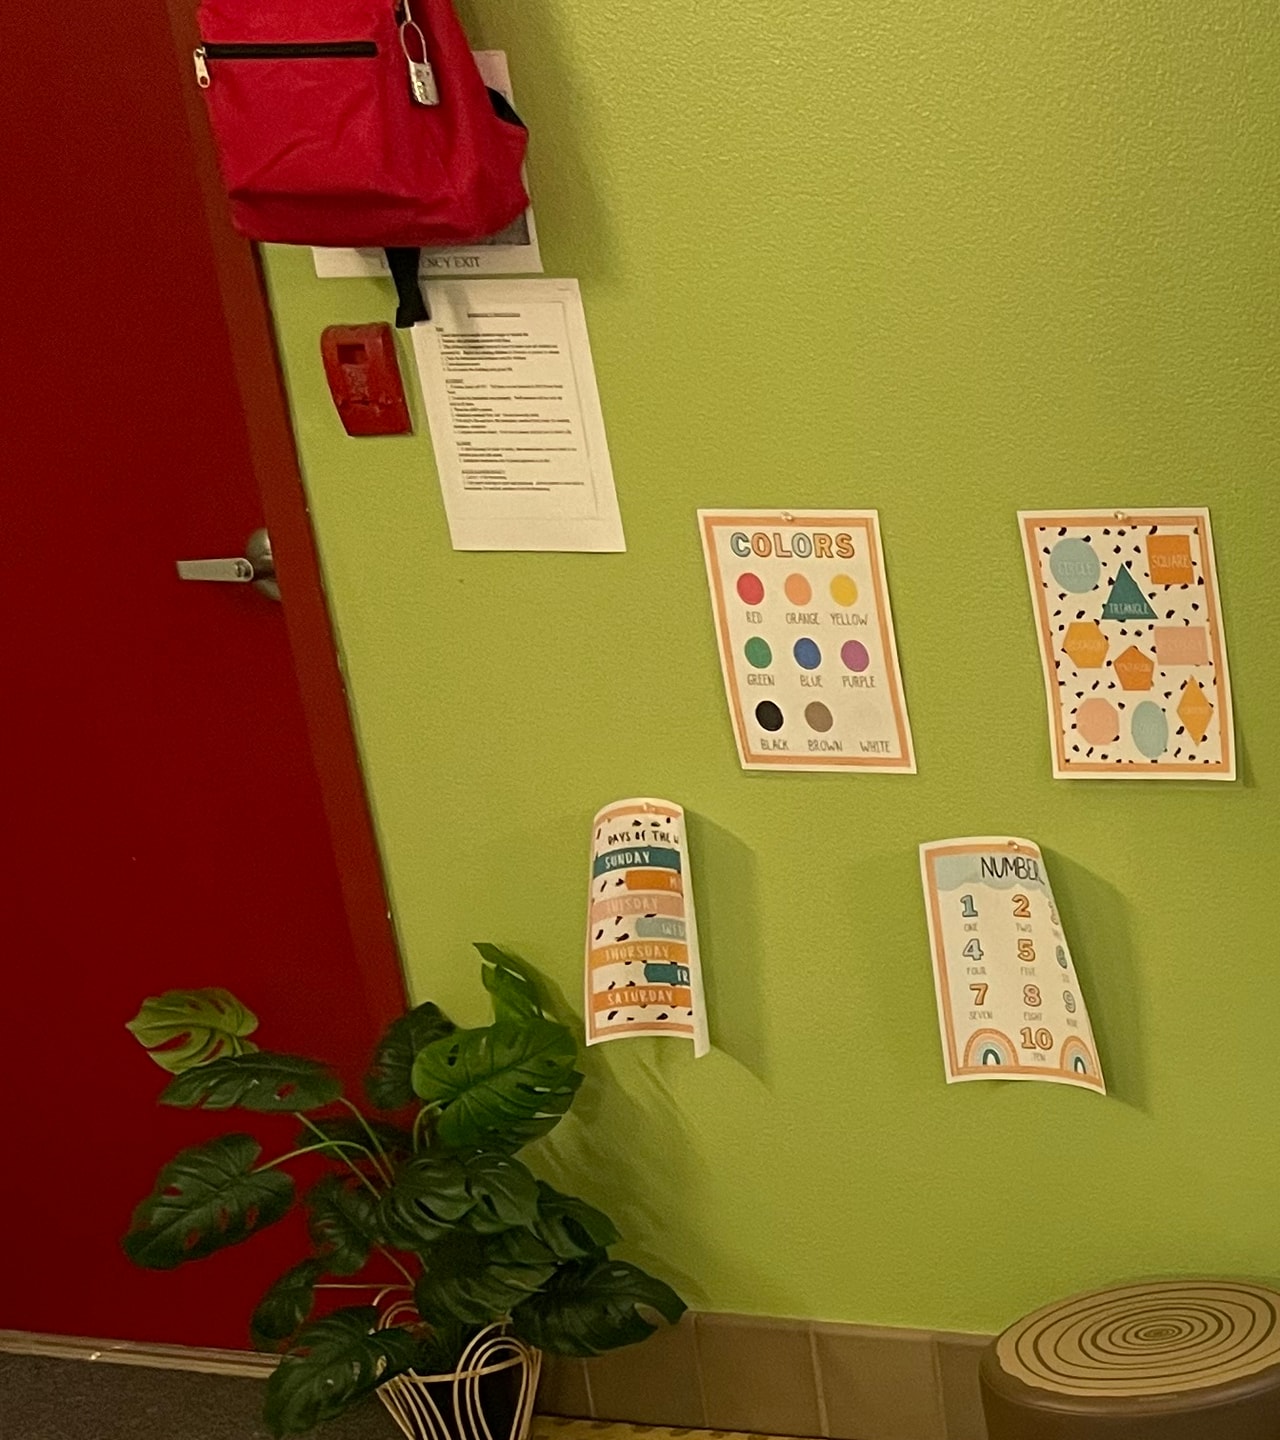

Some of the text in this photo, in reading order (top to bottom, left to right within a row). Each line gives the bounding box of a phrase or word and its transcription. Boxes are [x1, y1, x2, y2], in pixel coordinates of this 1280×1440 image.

[454, 255, 480, 268] EXIT
[729, 531, 855, 559] COLORS
[1151, 554, 1190, 569] SQUARE
[1109, 602, 1150, 615] TRIANGLE
[745, 610, 869, 626] RED ORANGE YELLOW
[746, 673, 876, 689] GREEN BLUE PURPLE
[759, 738, 891, 753] BLACK BROWN WHITE
[607, 831, 631, 845] DAYS
[651, 830, 671, 844] THE
[605, 851, 650, 870] SUNDAY
[960, 894, 979, 918] 1
[1011, 893, 1032, 918] 2
[605, 945, 670, 961] THURSDAY
[962, 938, 984, 961] 4
[1017, 938, 1036, 962] 5
[966, 966, 987, 976] FOUR
[607, 990, 673, 1005] SATURDAY
[969, 983, 1077, 1014] 7 8 9
[968, 1010, 993, 1021] SEVEN
[1020, 1026, 1054, 1051] 10
